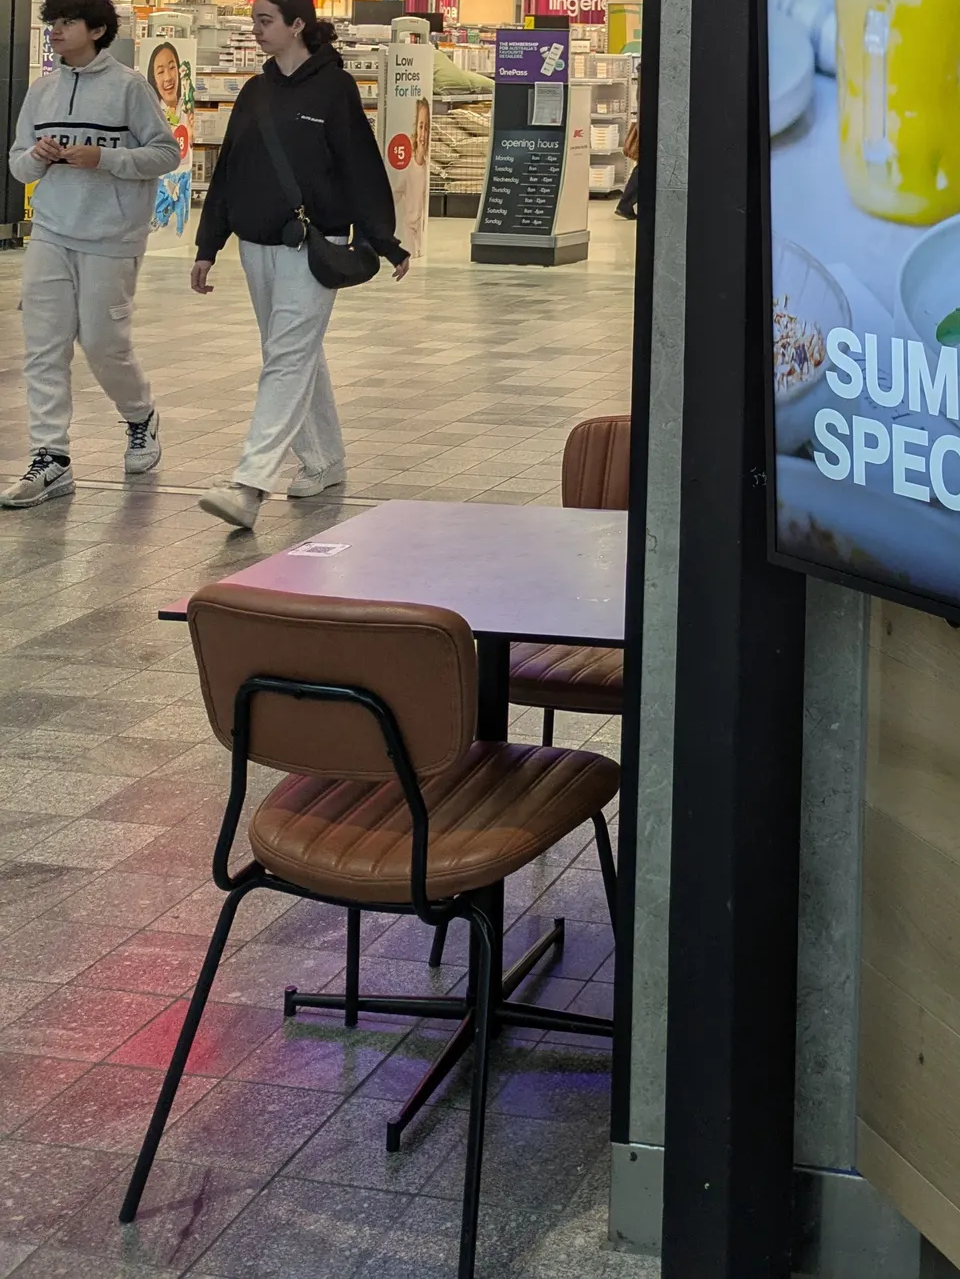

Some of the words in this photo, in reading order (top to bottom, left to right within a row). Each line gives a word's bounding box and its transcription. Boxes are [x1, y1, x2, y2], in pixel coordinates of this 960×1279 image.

[395, 54, 414, 66] Low
[394, 69, 420, 84] prices
[499, 67, 528, 76] OnePass
[394, 86, 408, 97] for
[410, 85, 422, 97] life
[501, 139, 535, 150] opening
[537, 139, 559, 148] hours
[394, 146, 405, 160] $5
